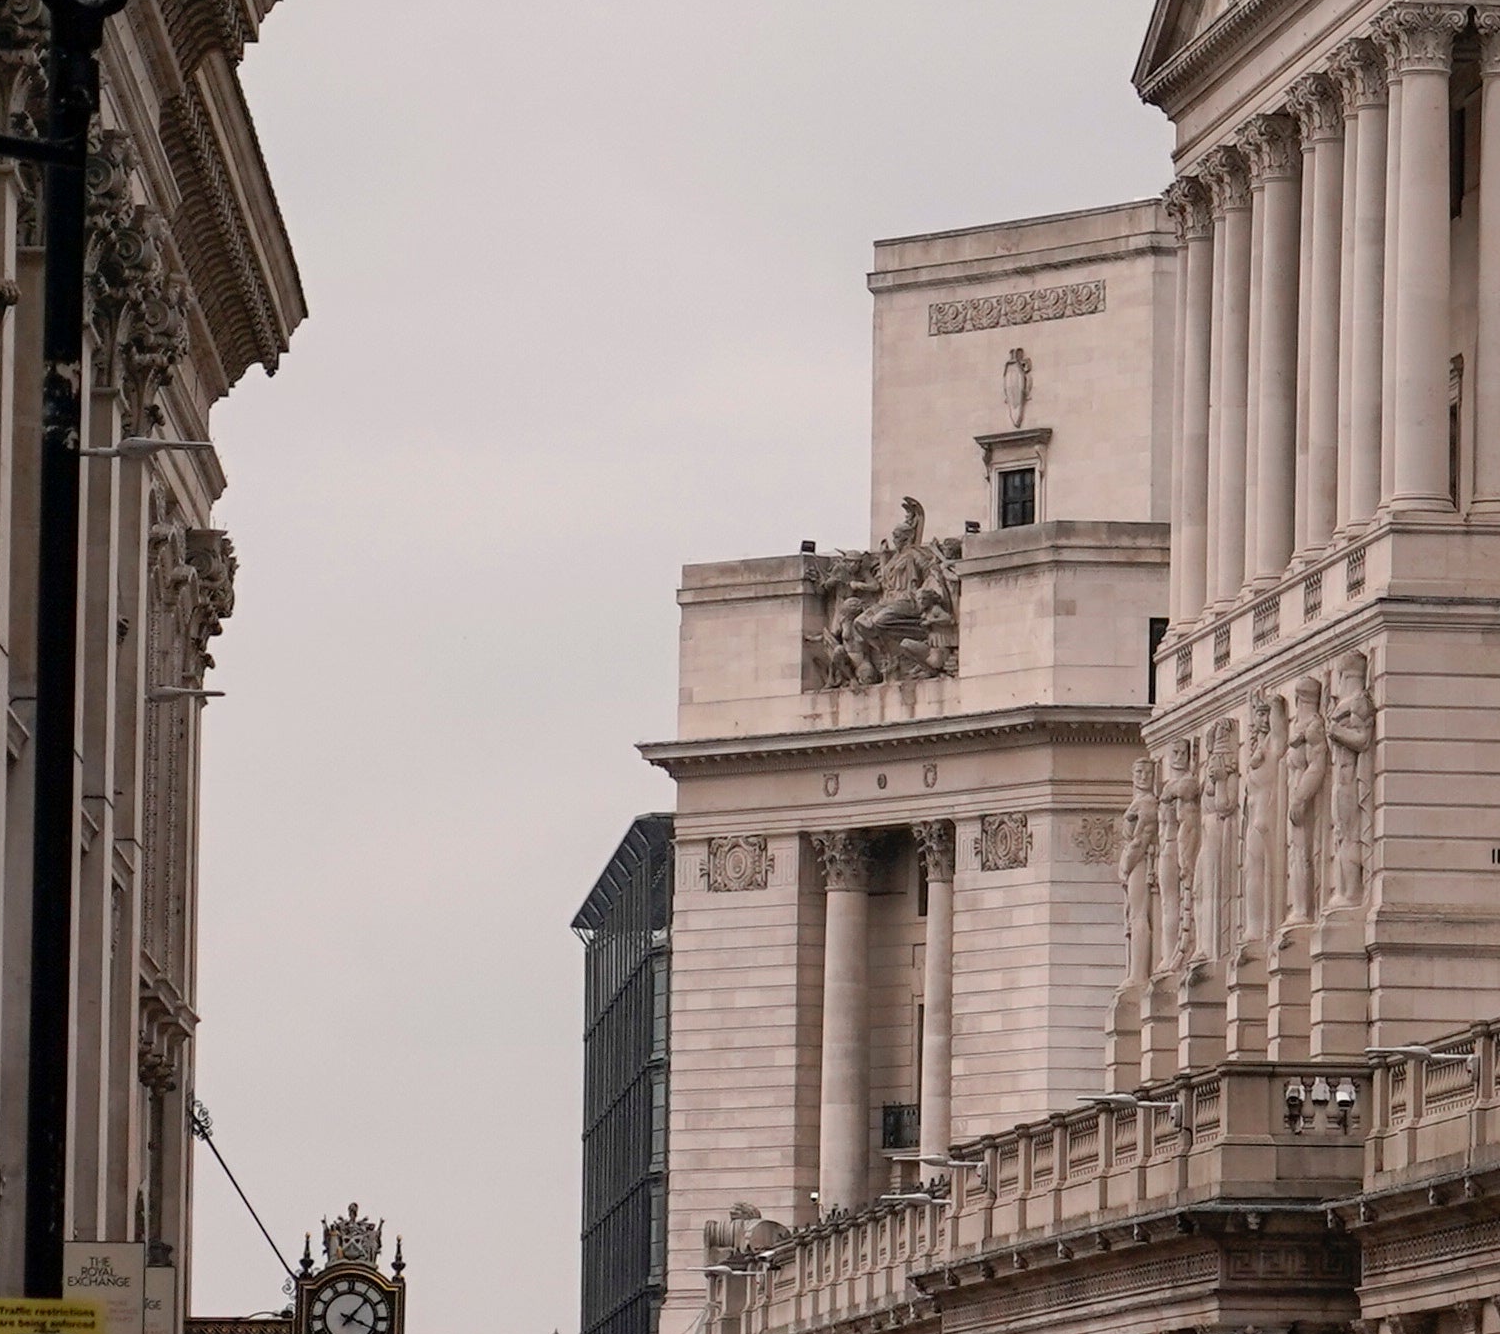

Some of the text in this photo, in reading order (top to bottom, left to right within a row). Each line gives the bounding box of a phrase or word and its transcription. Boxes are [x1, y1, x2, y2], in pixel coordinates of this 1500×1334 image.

[88, 1256, 111, 1267] THE
[81, 1267, 117, 1278] ROYAL
[67, 1276, 131, 1288] EXCHANGE
[34, 1307, 95, 1317] restrictions
[18, 1318, 47, 1330] being
[49, 1319, 95, 1329] enforced
